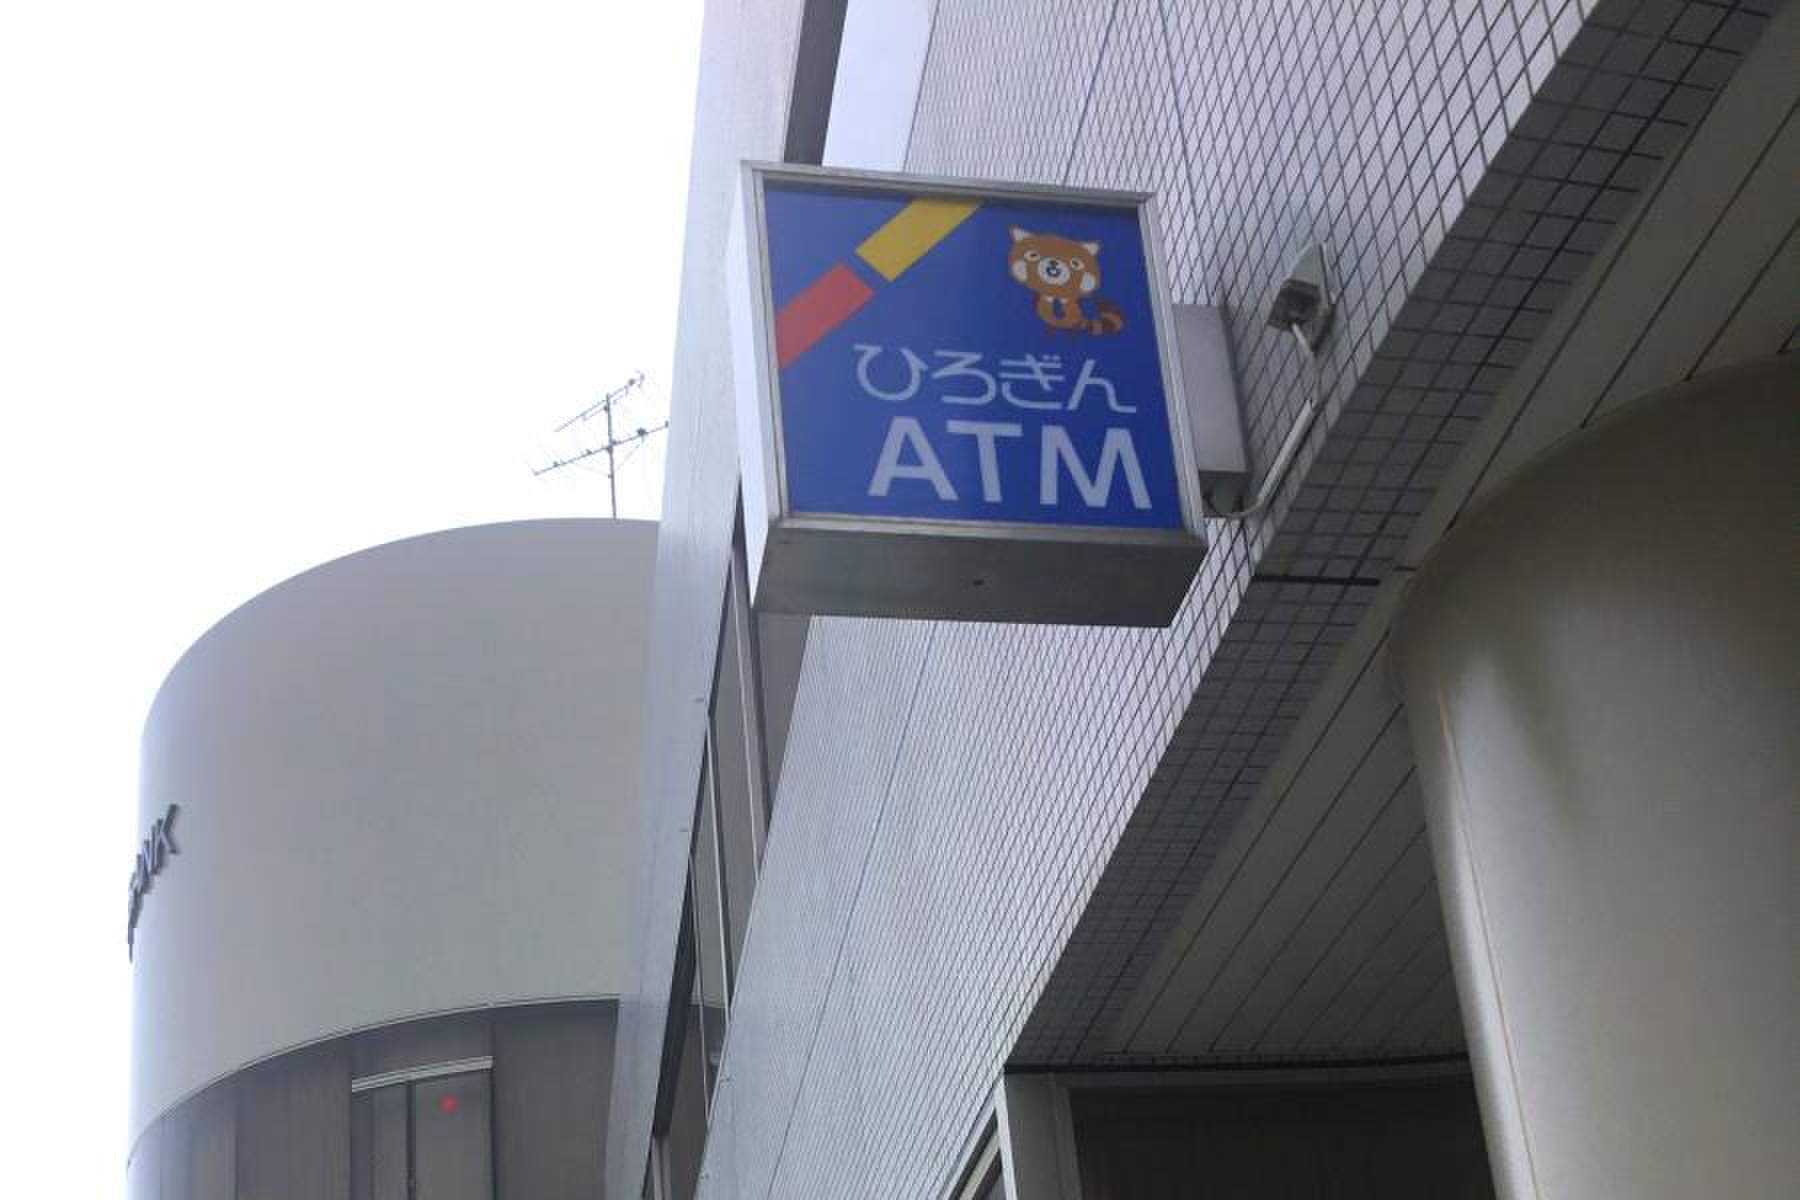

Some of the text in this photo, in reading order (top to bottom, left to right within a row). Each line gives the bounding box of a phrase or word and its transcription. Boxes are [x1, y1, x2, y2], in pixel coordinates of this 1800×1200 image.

[853, 343, 1138, 414] ひろぎん
[867, 415, 1152, 510] ATM
